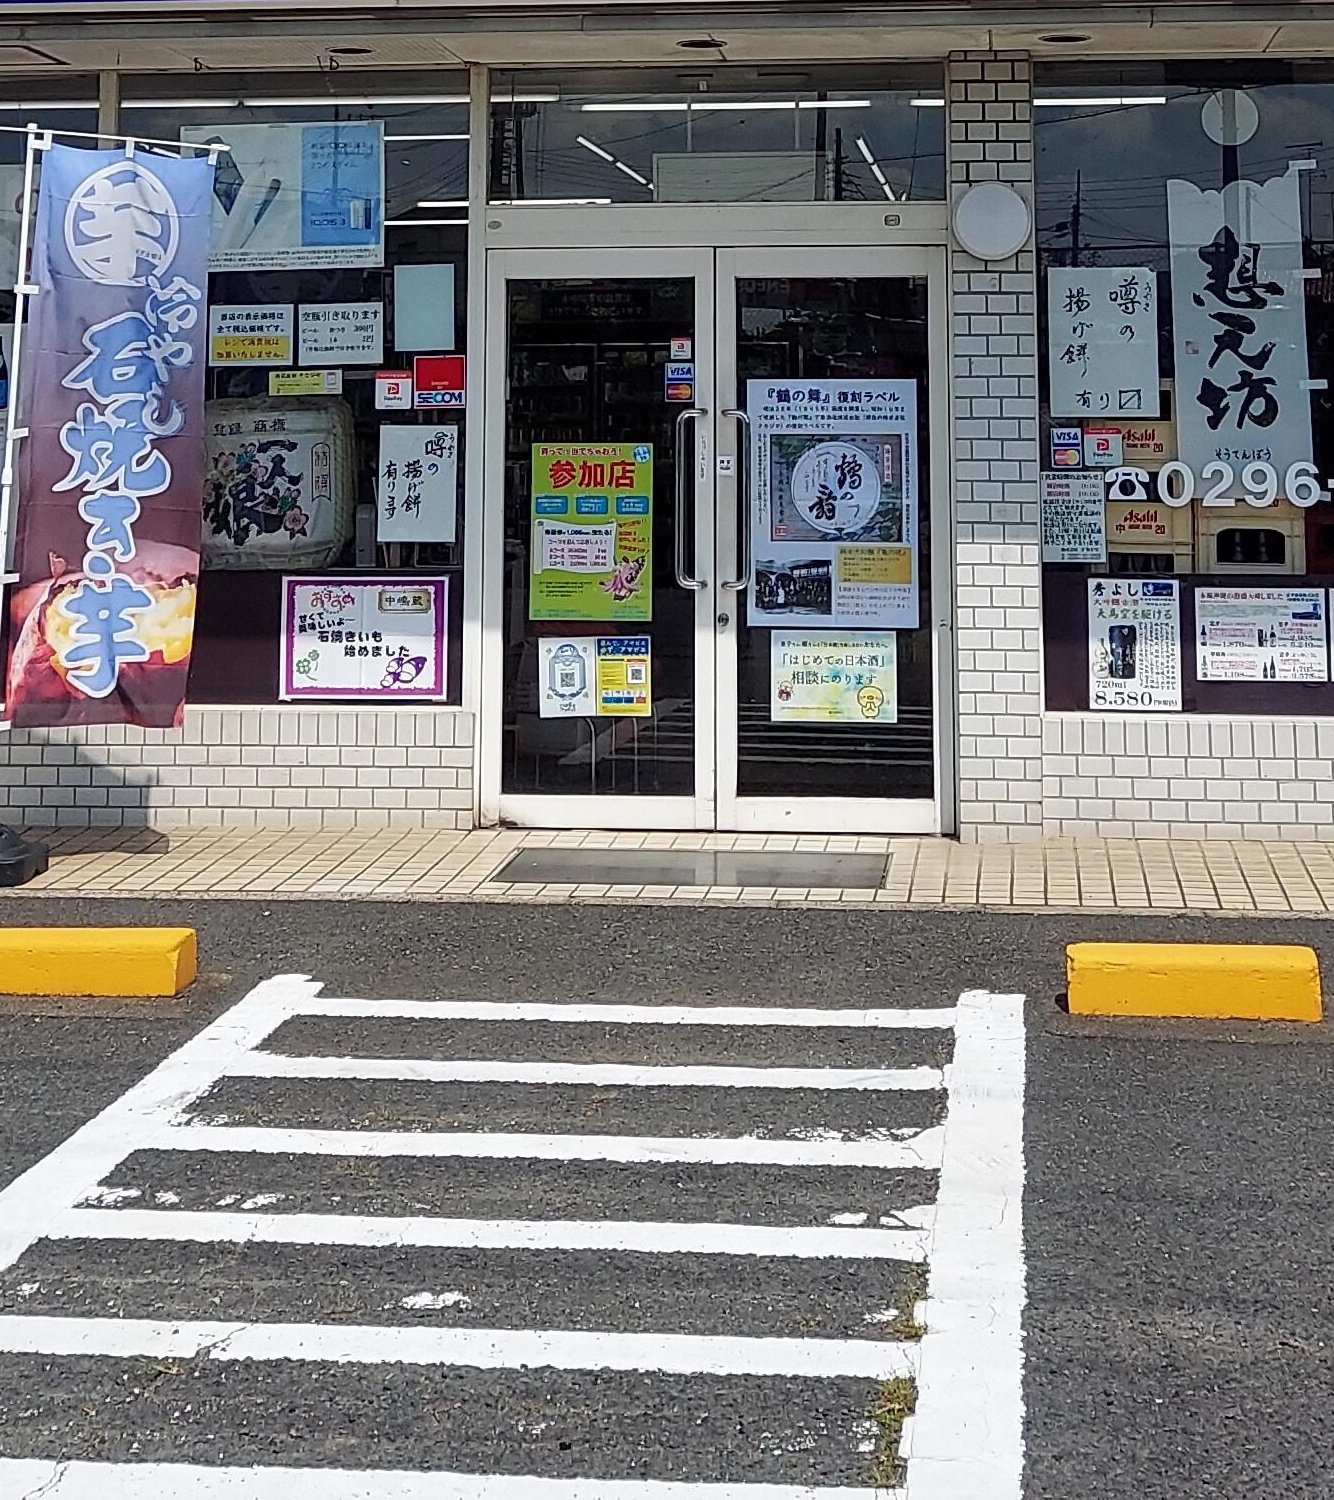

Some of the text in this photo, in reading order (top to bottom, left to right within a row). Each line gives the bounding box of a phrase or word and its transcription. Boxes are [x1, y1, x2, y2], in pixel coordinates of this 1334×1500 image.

[142, 274, 203, 436] 冷やし
[670, 366, 693, 376] VISA
[418, 392, 463, 404] SECOM
[1055, 432, 1079, 441] VISA
[549, 459, 636, 489] 参加店
[51, 310, 170, 700] 石焼き芋
